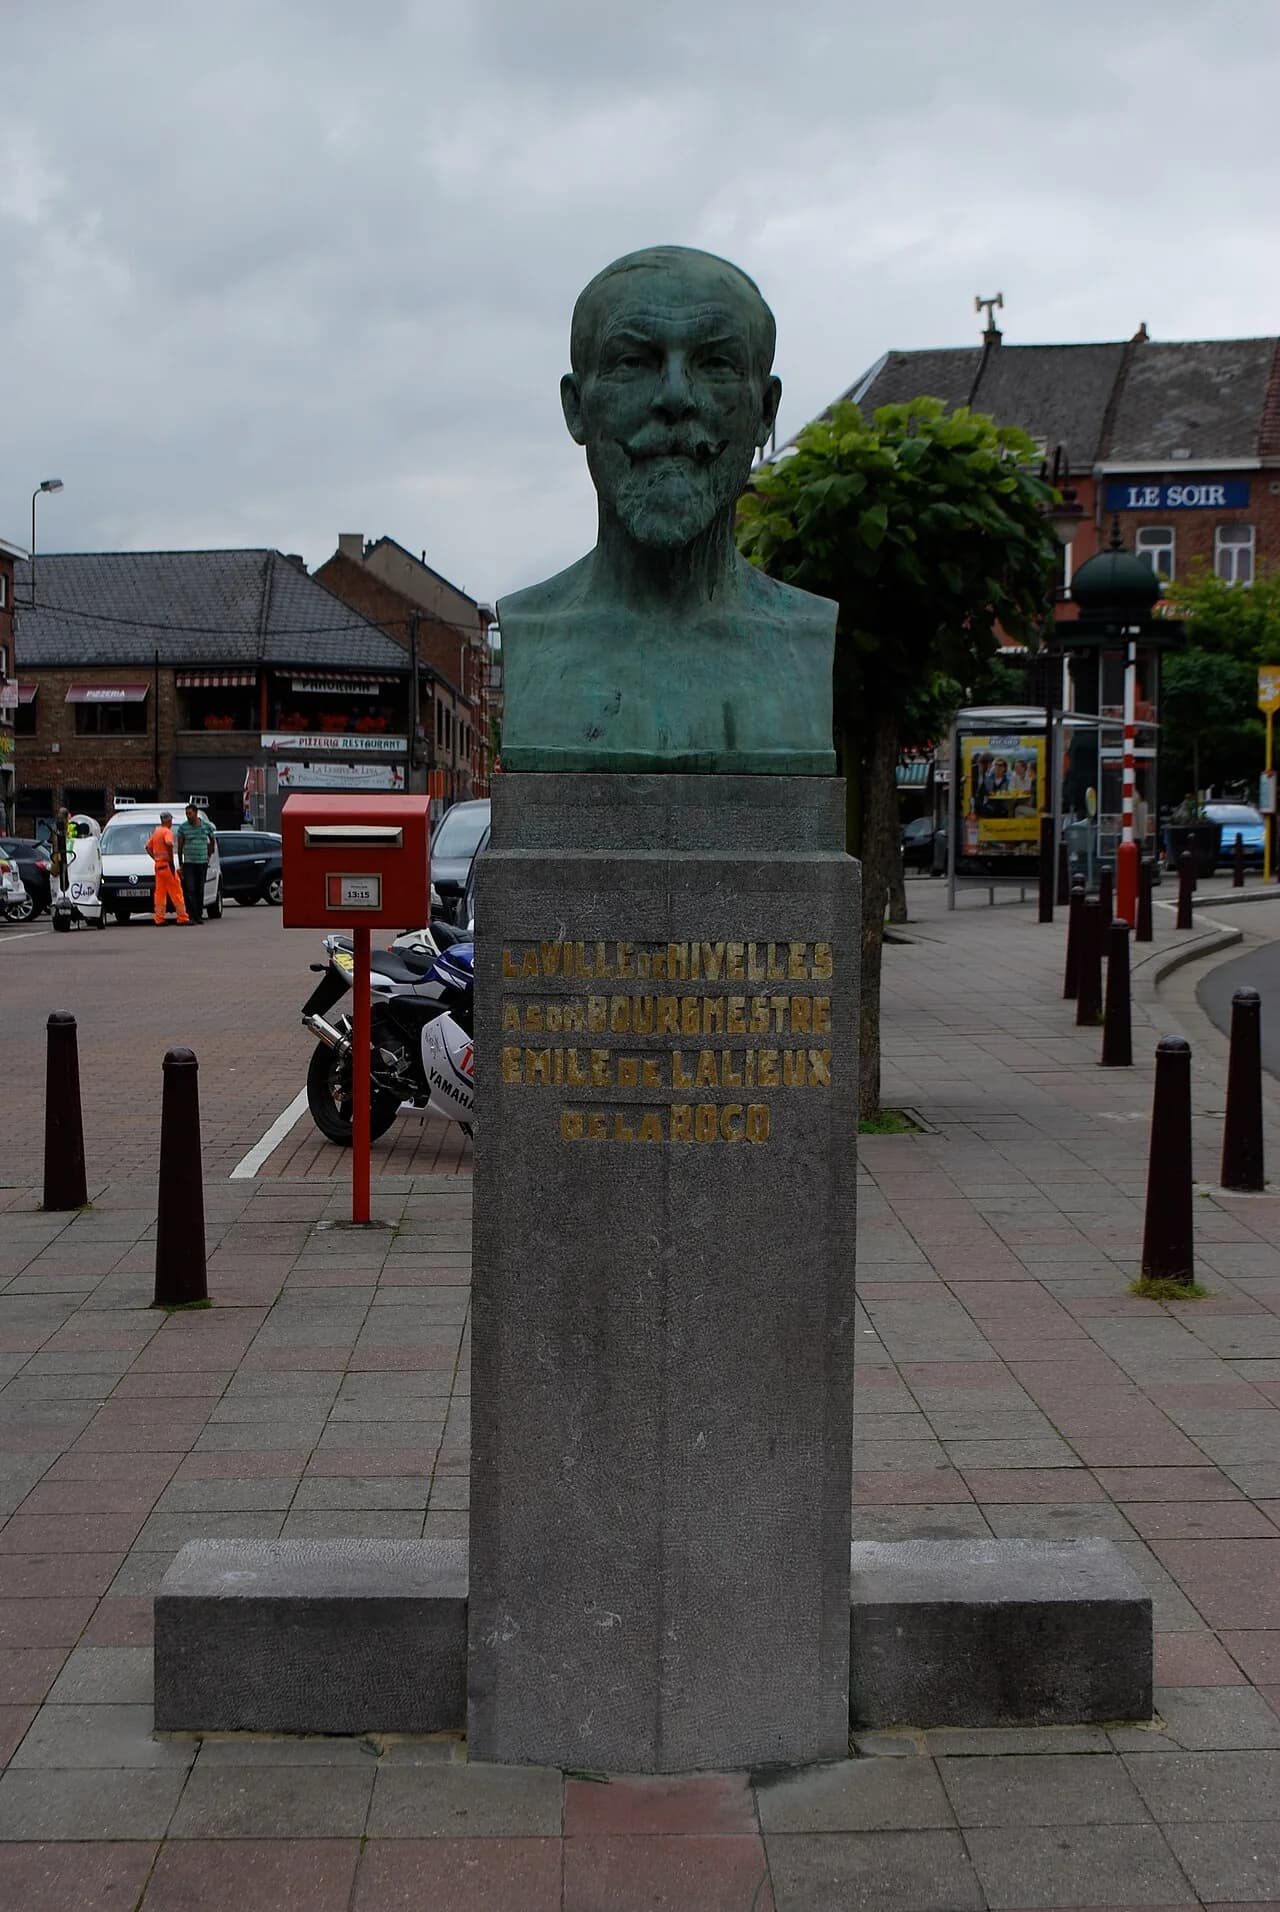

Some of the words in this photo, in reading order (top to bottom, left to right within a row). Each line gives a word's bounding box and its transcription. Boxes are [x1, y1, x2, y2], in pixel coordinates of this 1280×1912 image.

[1127, 486, 1160, 508] LE
[1166, 485, 1227, 507] SOIR
[86, 689, 125, 698] PIZZERIA
[302, 680, 370, 692] PANORAMA
[299, 737, 339, 748] PIZZERIA
[342, 738, 401, 750] RESTAURANT
[347, 891, 370, 899] 13:15
[502, 949, 539, 978] LA
[540, 940, 635, 979] VILLE
[637, 950, 668, 980] DE
[667, 942, 834, 981] NIVELLES
[502, 1003, 521, 1033] A
[586, 995, 833, 1035] BOURGMESTRE
[502, 1046, 612, 1087] EMILE
[618, 1056, 663, 1088] DE
[672, 1049, 833, 1089] LALIEUX
[560, 1110, 608, 1141] DE
[614, 1112, 663, 1142] LA
